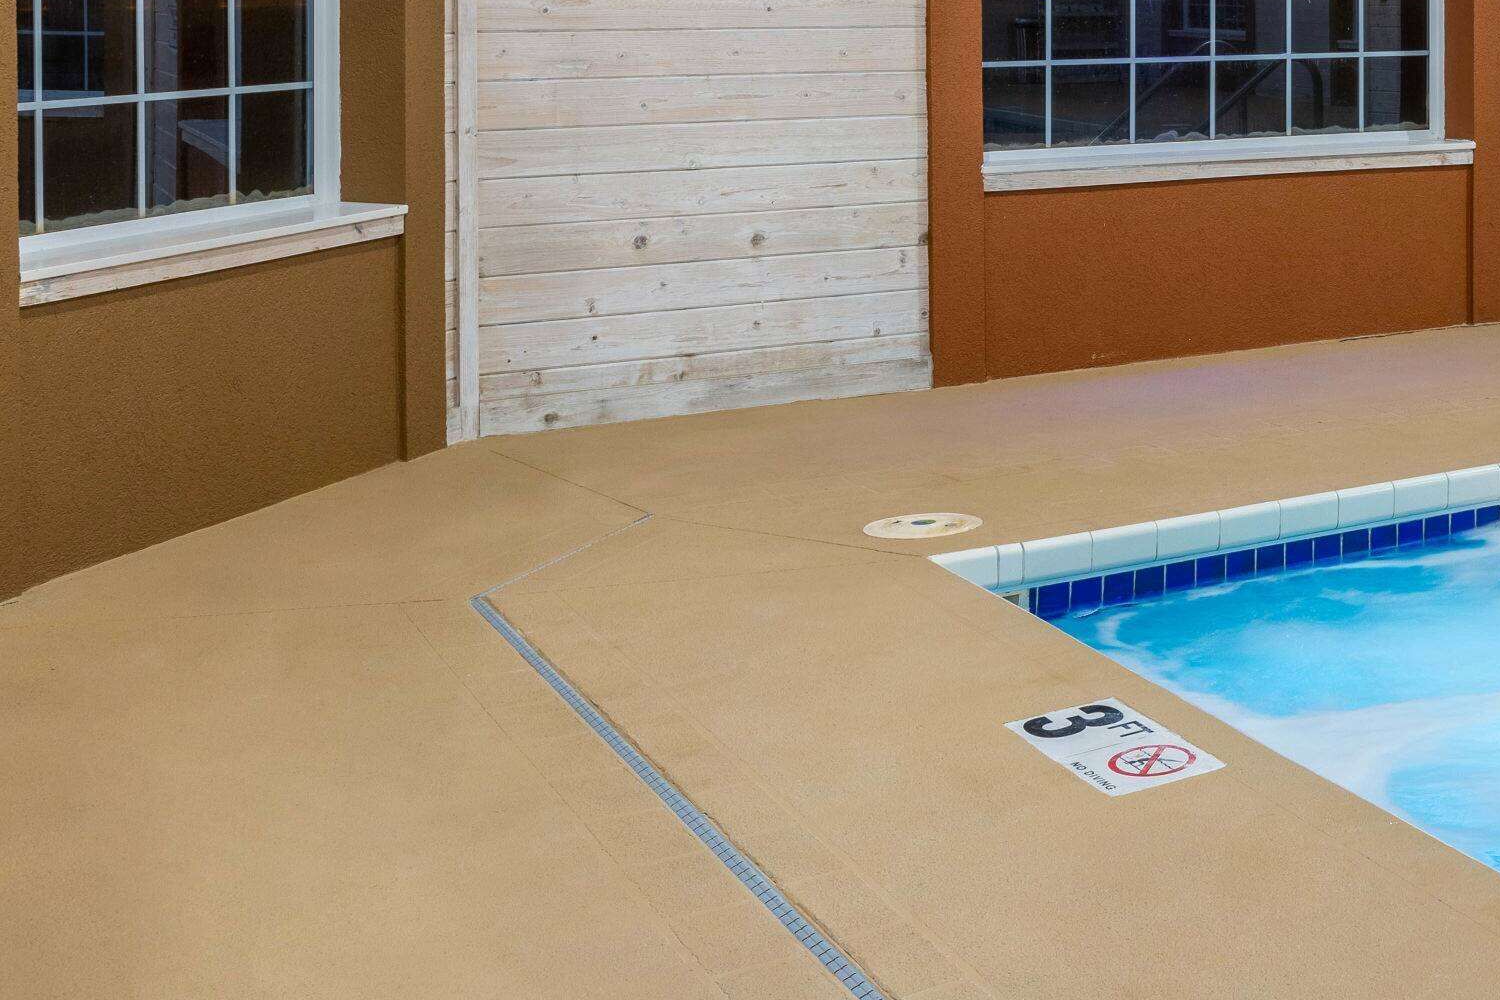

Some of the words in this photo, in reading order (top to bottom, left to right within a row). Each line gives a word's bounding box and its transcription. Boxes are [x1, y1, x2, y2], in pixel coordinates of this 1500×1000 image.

[1023, 704, 1124, 738] 3
[1107, 720, 1154, 738] FT
[1070, 760, 1087, 771] NO
[1083, 770, 1117, 791] DIVING
